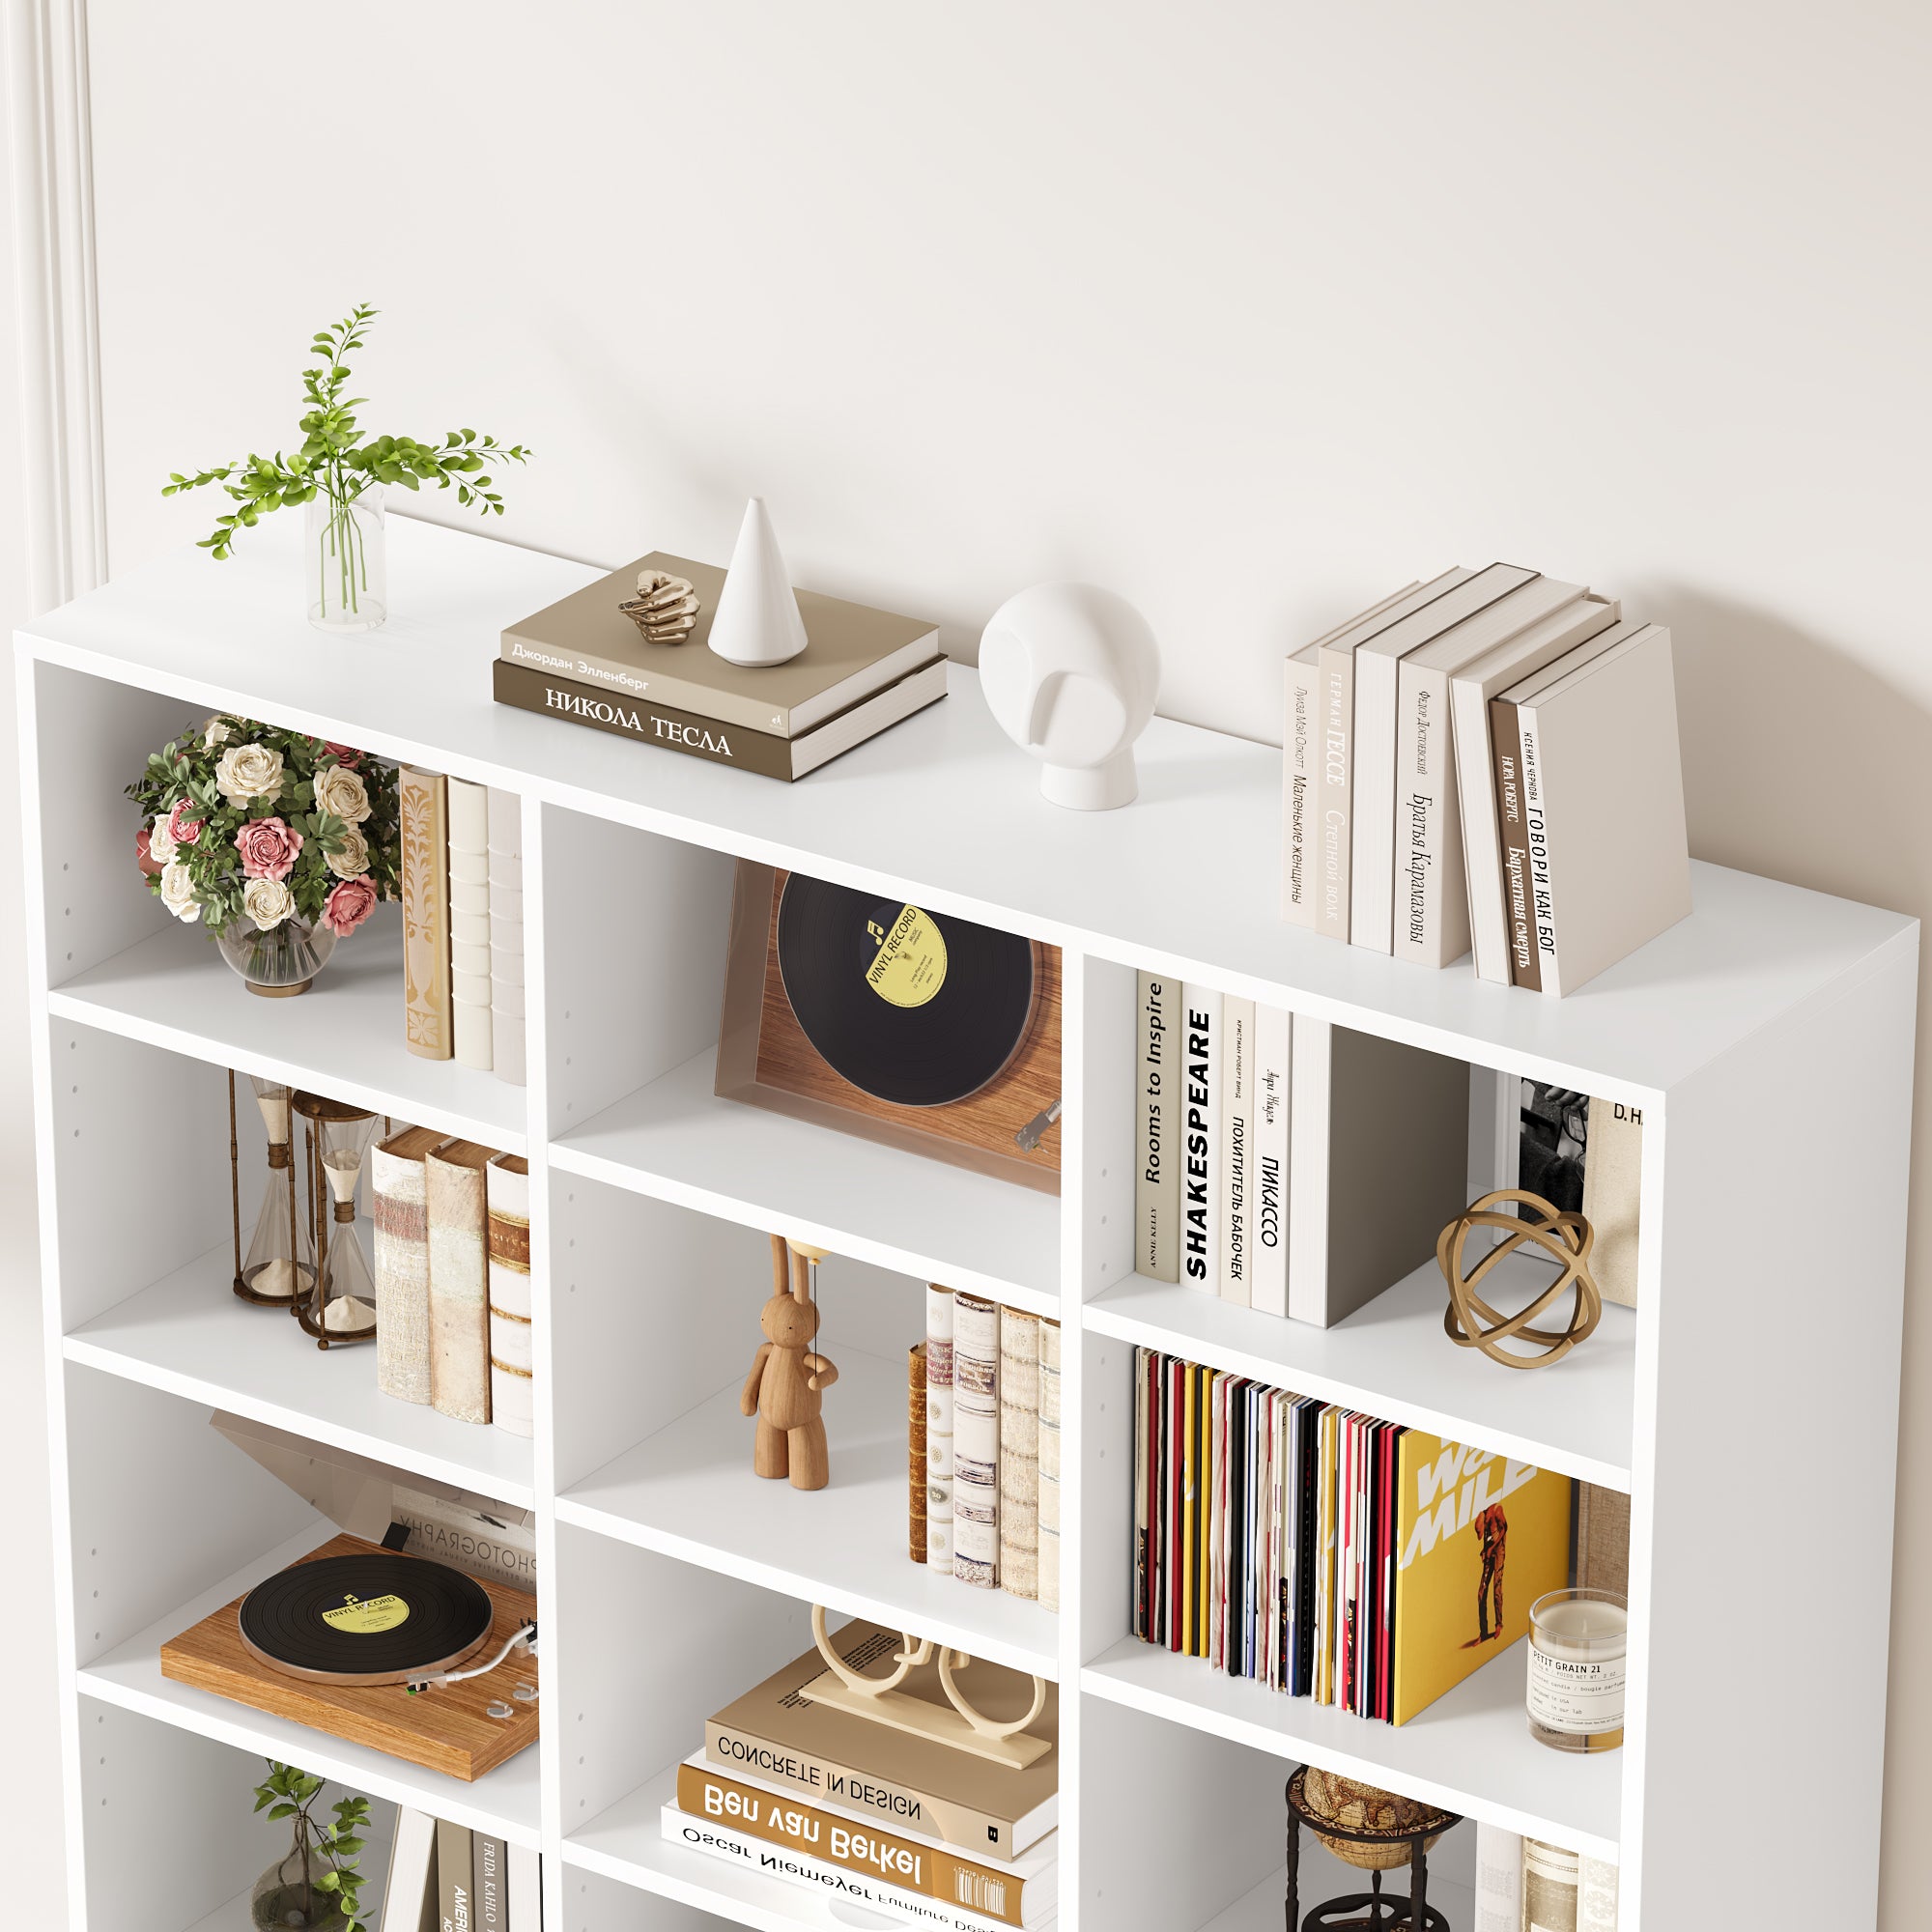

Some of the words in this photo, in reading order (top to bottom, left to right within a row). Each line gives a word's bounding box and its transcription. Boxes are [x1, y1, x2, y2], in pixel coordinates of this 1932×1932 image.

[512, 643, 573, 670] Джордан
[578, 661, 649, 692] Элленберг
[545, 688, 643, 733] НИКОЛА
[651, 716, 733, 757] ТЕСЛА
[1294, 686, 1308, 714] Луиза
[1329, 672, 1343, 726] ГЕРМАН
[1294, 716, 1307, 735] Мэй
[1523, 731, 1535, 765] КСЕНИЯ
[1294, 737, 1307, 769] Олкотт
[1325, 727, 1347, 786] ГЕССЕ
[1501, 755, 1514, 781] НОРА
[1293, 775, 1307, 843] Маленькие
[1504, 781, 1520, 823] РОБЕРТС
[1528, 769, 1538, 801] ЧЕРНОВА
[1406, 792, 1433, 846] Братья
[1528, 808, 1548, 884] ГОВОРИ
[1291, 845, 1304, 904] женщины
[1405, 850, 1432, 944] Карамазовы
[1506, 846, 1526, 920] Бархатная
[1535, 889, 1552, 919] КАК
[869, 953, 893, 984] VINYL
[887, 908, 917, 953] RECORD
[1512, 923, 1531, 968] смерть
[1539, 926, 1555, 955] БОГ
[1146, 982, 1167, 1065] Inspire
[1148, 1072, 1161, 1096] to
[1146, 1104, 1161, 1184] Rooms
[1186, 1009, 1209, 1281] SHAKESPEARE
[1232, 1117, 1244, 1210] ПОХИТИТЕЛЬ
[1262, 1155, 1279, 1248] ПИКАССО
[1231, 1213, 1243, 1281] БАБОЧЕК
[326, 1607, 355, 1619] VINYL
[1533, 1650, 1552, 1667] PETIT
[1555, 1662, 1587, 1673] GRAIN
[484, 1842, 496, 1877] FRIDA
[485, 1882, 497, 1922] KAHLO
